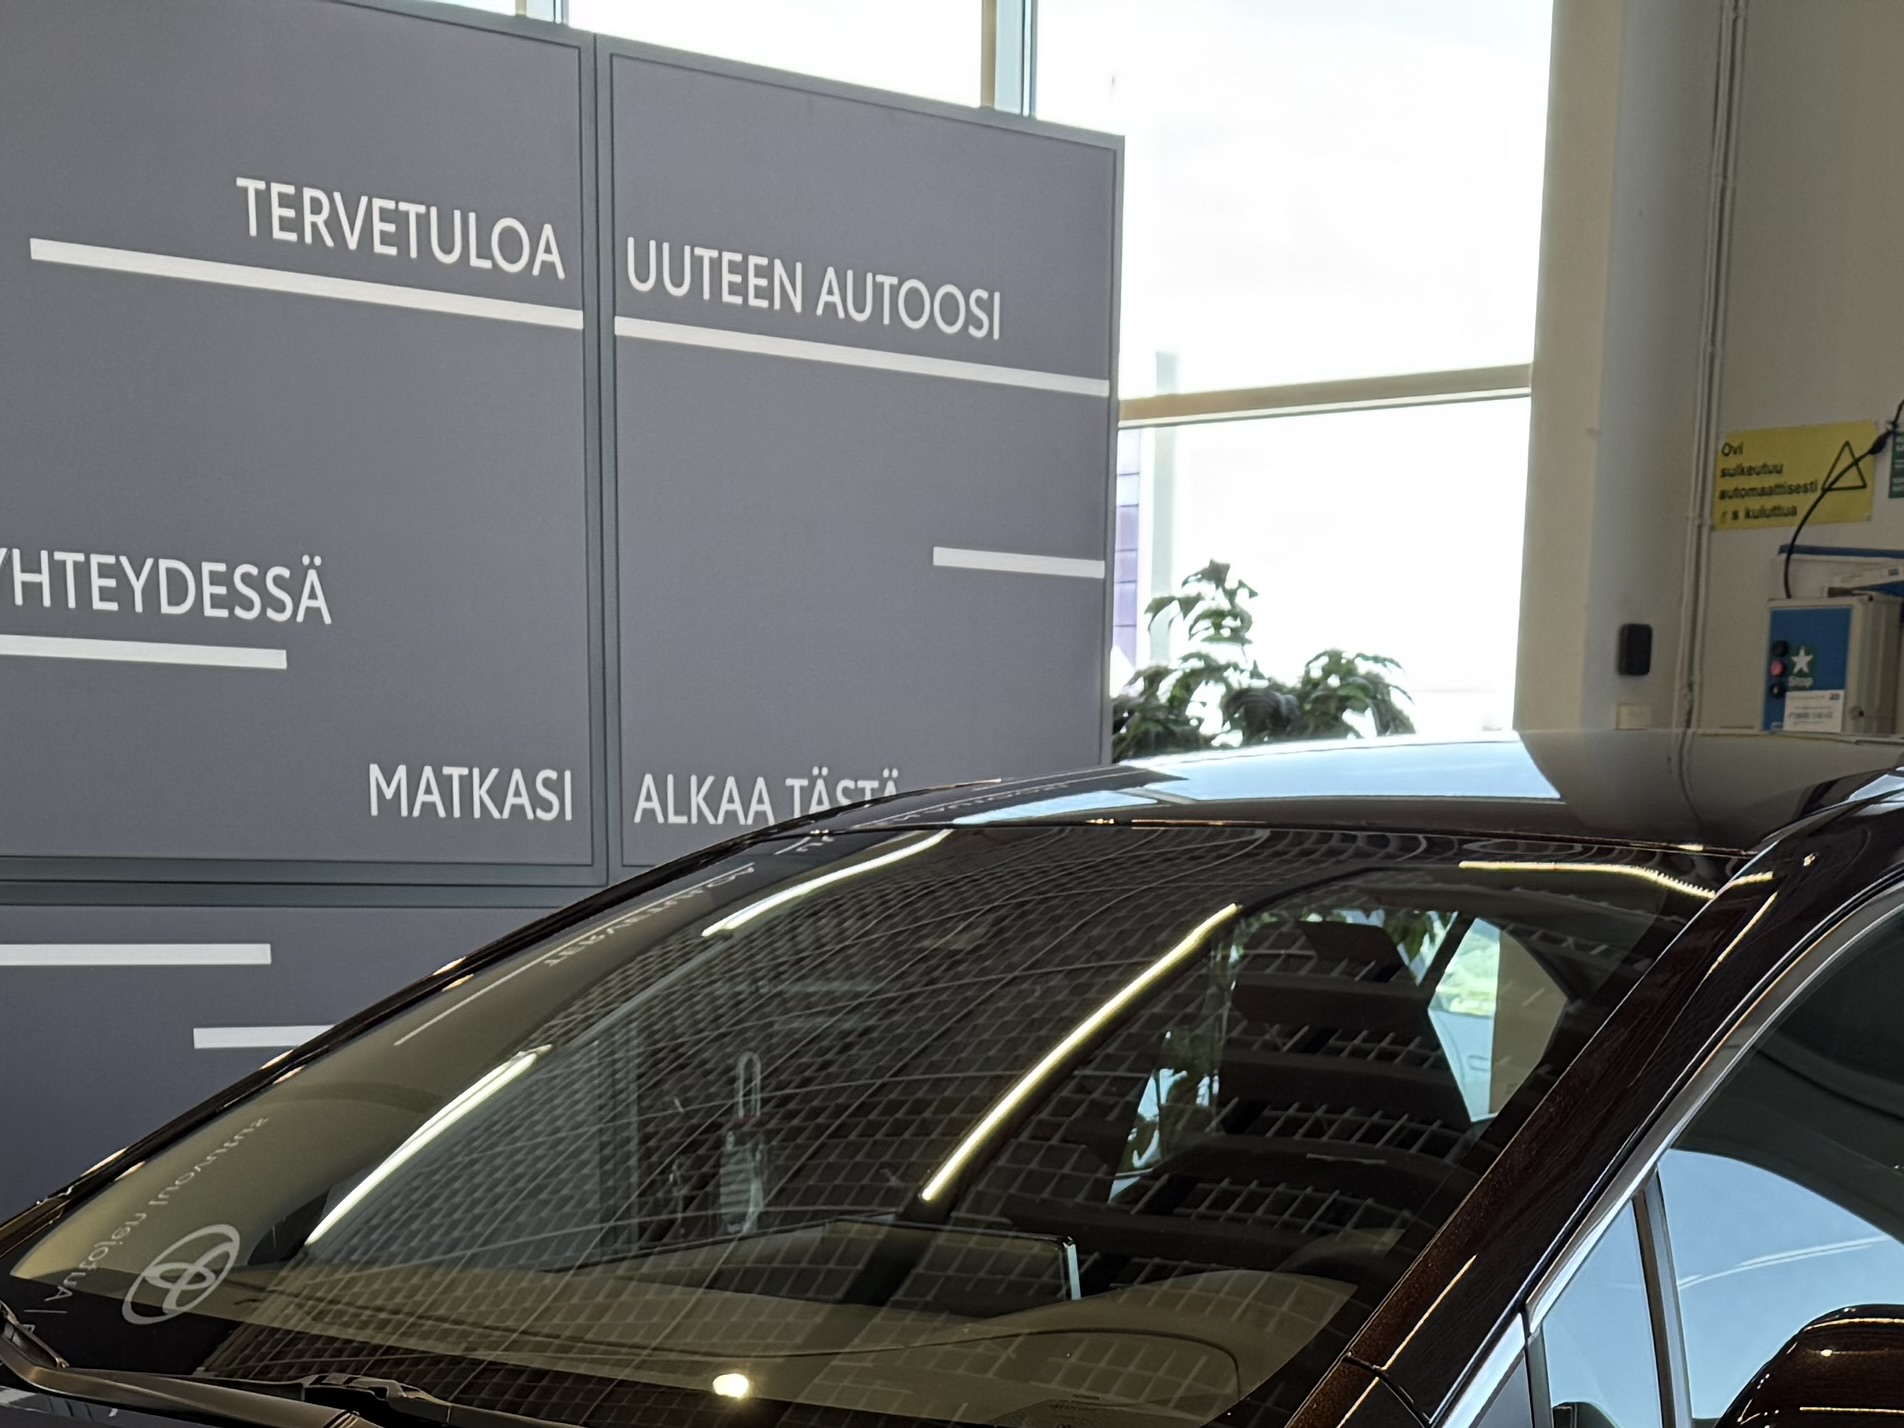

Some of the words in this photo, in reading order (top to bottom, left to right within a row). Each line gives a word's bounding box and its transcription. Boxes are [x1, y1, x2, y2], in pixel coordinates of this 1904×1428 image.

[235, 176, 566, 281] TERVETULOA
[626, 236, 803, 314] UUTEEN
[815, 265, 1001, 341] AUTOOSI
[1720, 441, 1744, 457] Ovi
[1719, 462, 1784, 478] sulkeutuu
[1718, 479, 1818, 500] automaattisesti
[369, 763, 573, 822] MATKASI
[633, 772, 776, 827] ALKAA
